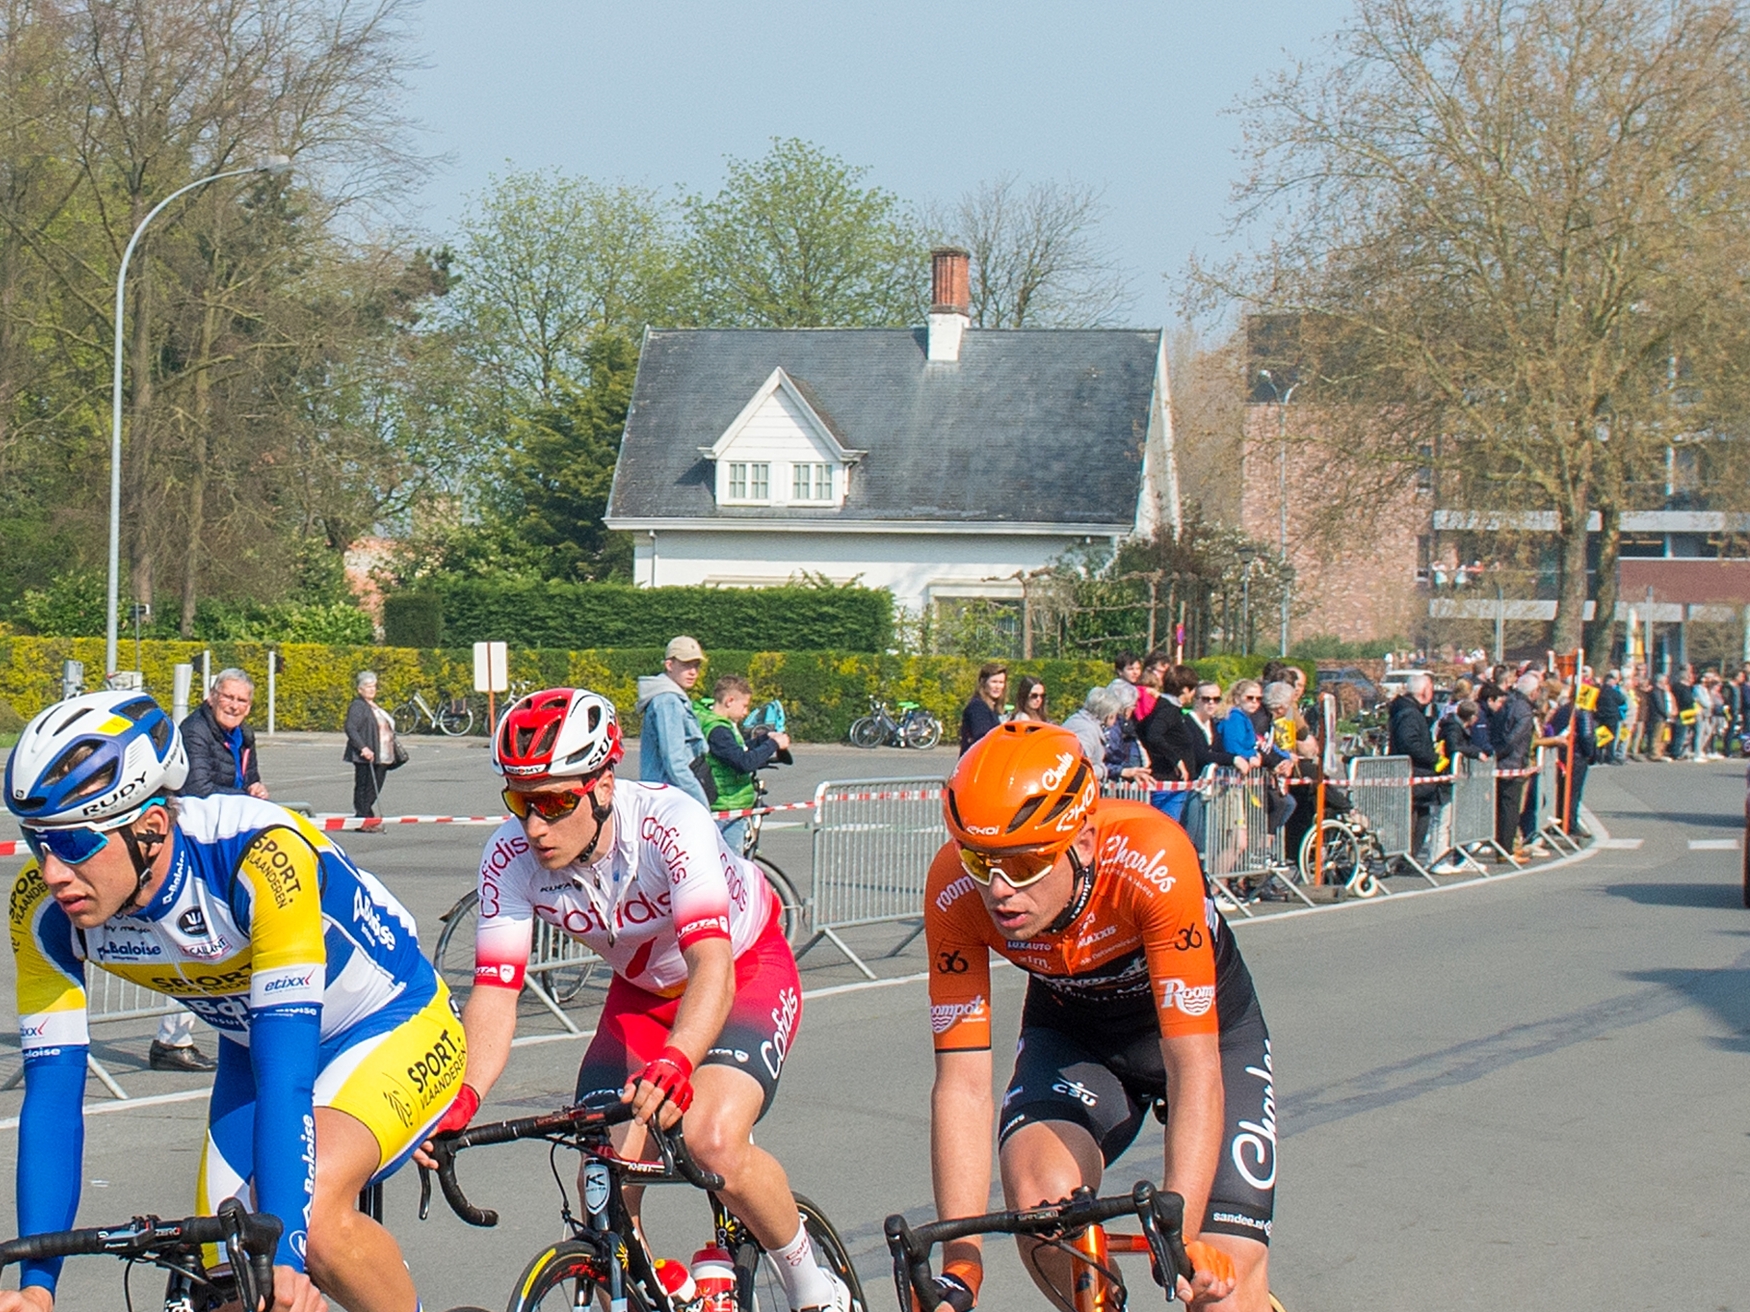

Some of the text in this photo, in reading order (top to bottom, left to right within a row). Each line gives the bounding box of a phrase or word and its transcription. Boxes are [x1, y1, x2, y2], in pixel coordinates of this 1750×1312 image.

[83, 771, 148, 816] RUDY
[481, 834, 530, 919] Cofidis
[1100, 834, 1177, 893] Charles
[15, 882, 49, 926] VLAANDE
[935, 875, 975, 912] room
[677, 917, 720, 938] UOTA
[1007, 940, 1052, 951] LUXAUTO
[108, 940, 162, 957] Baloise
[264, 974, 306, 993] etixx
[1159, 978, 1216, 1017] Room
[760, 987, 800, 1080] Cofidis
[301, 1113, 316, 1195] Baloise
